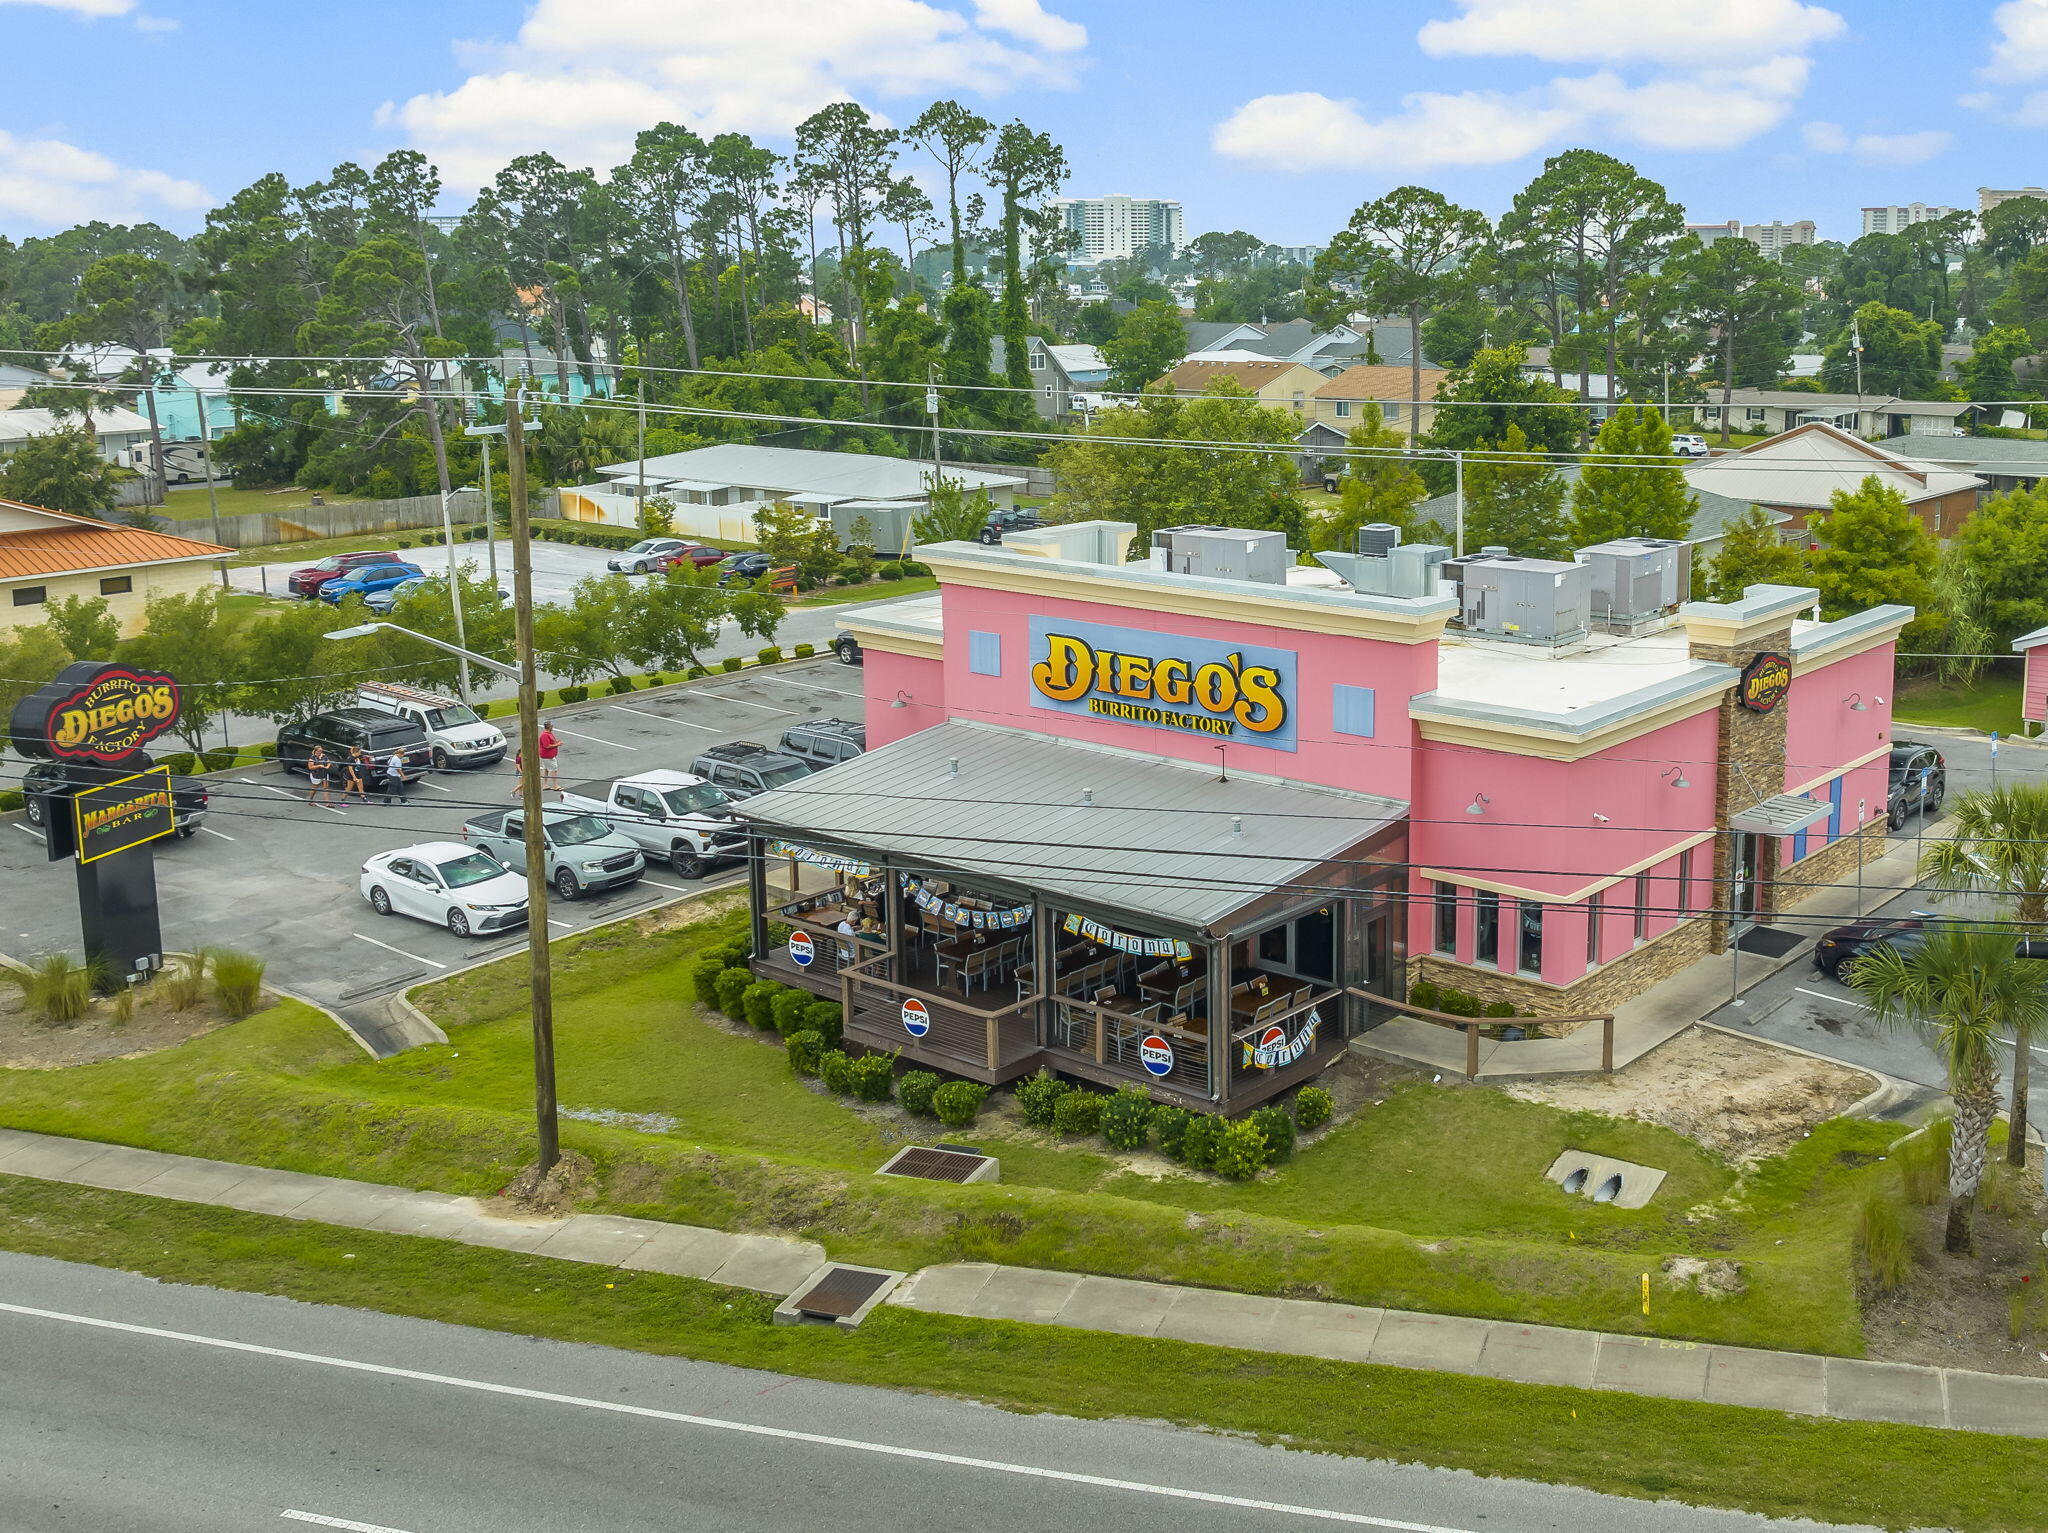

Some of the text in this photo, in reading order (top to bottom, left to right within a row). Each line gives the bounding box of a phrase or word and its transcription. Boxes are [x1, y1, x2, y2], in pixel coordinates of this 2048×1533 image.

[84, 678, 141, 709] BURRITO
[1031, 632, 1287, 733] DIEGO'S
[1747, 667, 1789, 700] DIEGO'S
[55, 685, 174, 749] DIEGO'S
[1088, 698, 1236, 736] BURRITO FACTORY
[87, 719, 147, 753] FACTORY
[82, 791, 169, 839] MARGARITA
[111, 812, 143, 829] BAR
[790, 941, 813, 956] PEPSI
[1084, 922, 1171, 952] Corona
[903, 1010, 928, 1025] PEPSI
[1142, 1048, 1172, 1064] PEPSI
